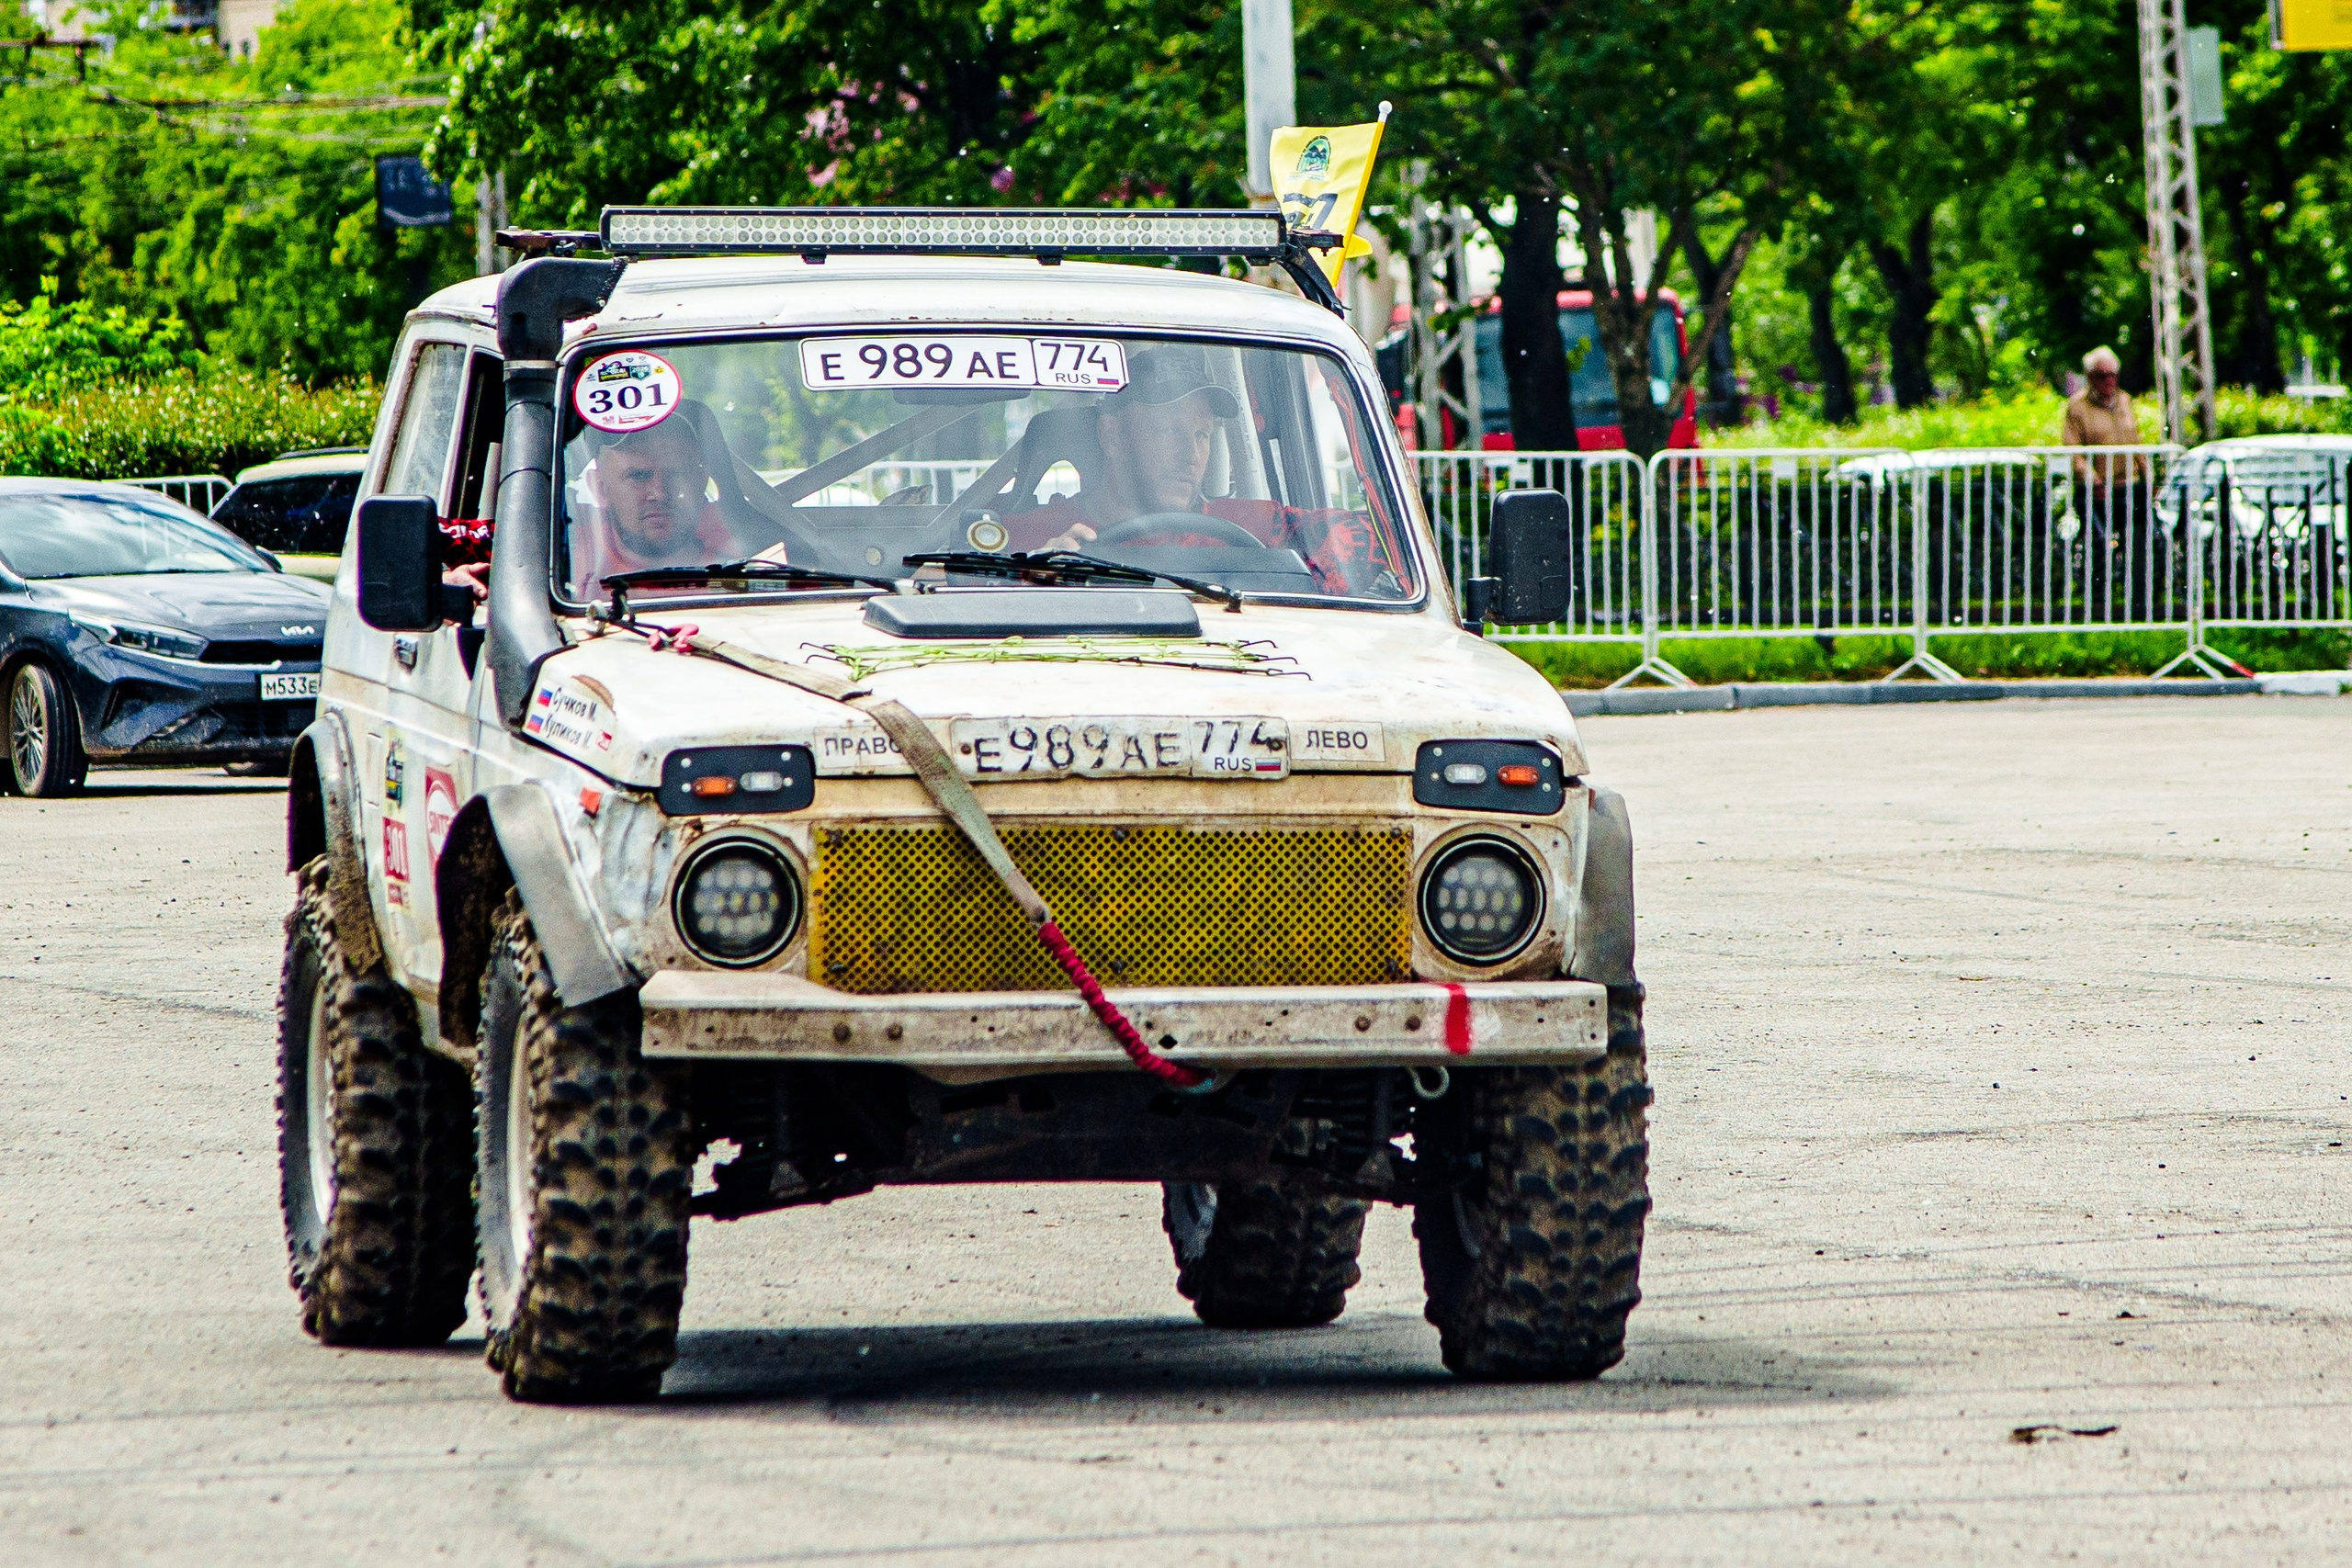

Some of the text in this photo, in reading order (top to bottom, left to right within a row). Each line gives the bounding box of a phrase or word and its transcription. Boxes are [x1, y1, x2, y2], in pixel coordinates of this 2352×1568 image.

[858, 343, 954, 379] 989
[1039, 342, 1109, 373] 774
[1055, 373, 1091, 385] RUS
[589, 383, 668, 414] 301
[1194, 720, 1284, 754] 774
[1306, 730, 1369, 750] ЛЕВО
[1214, 757, 1252, 772] RUS
